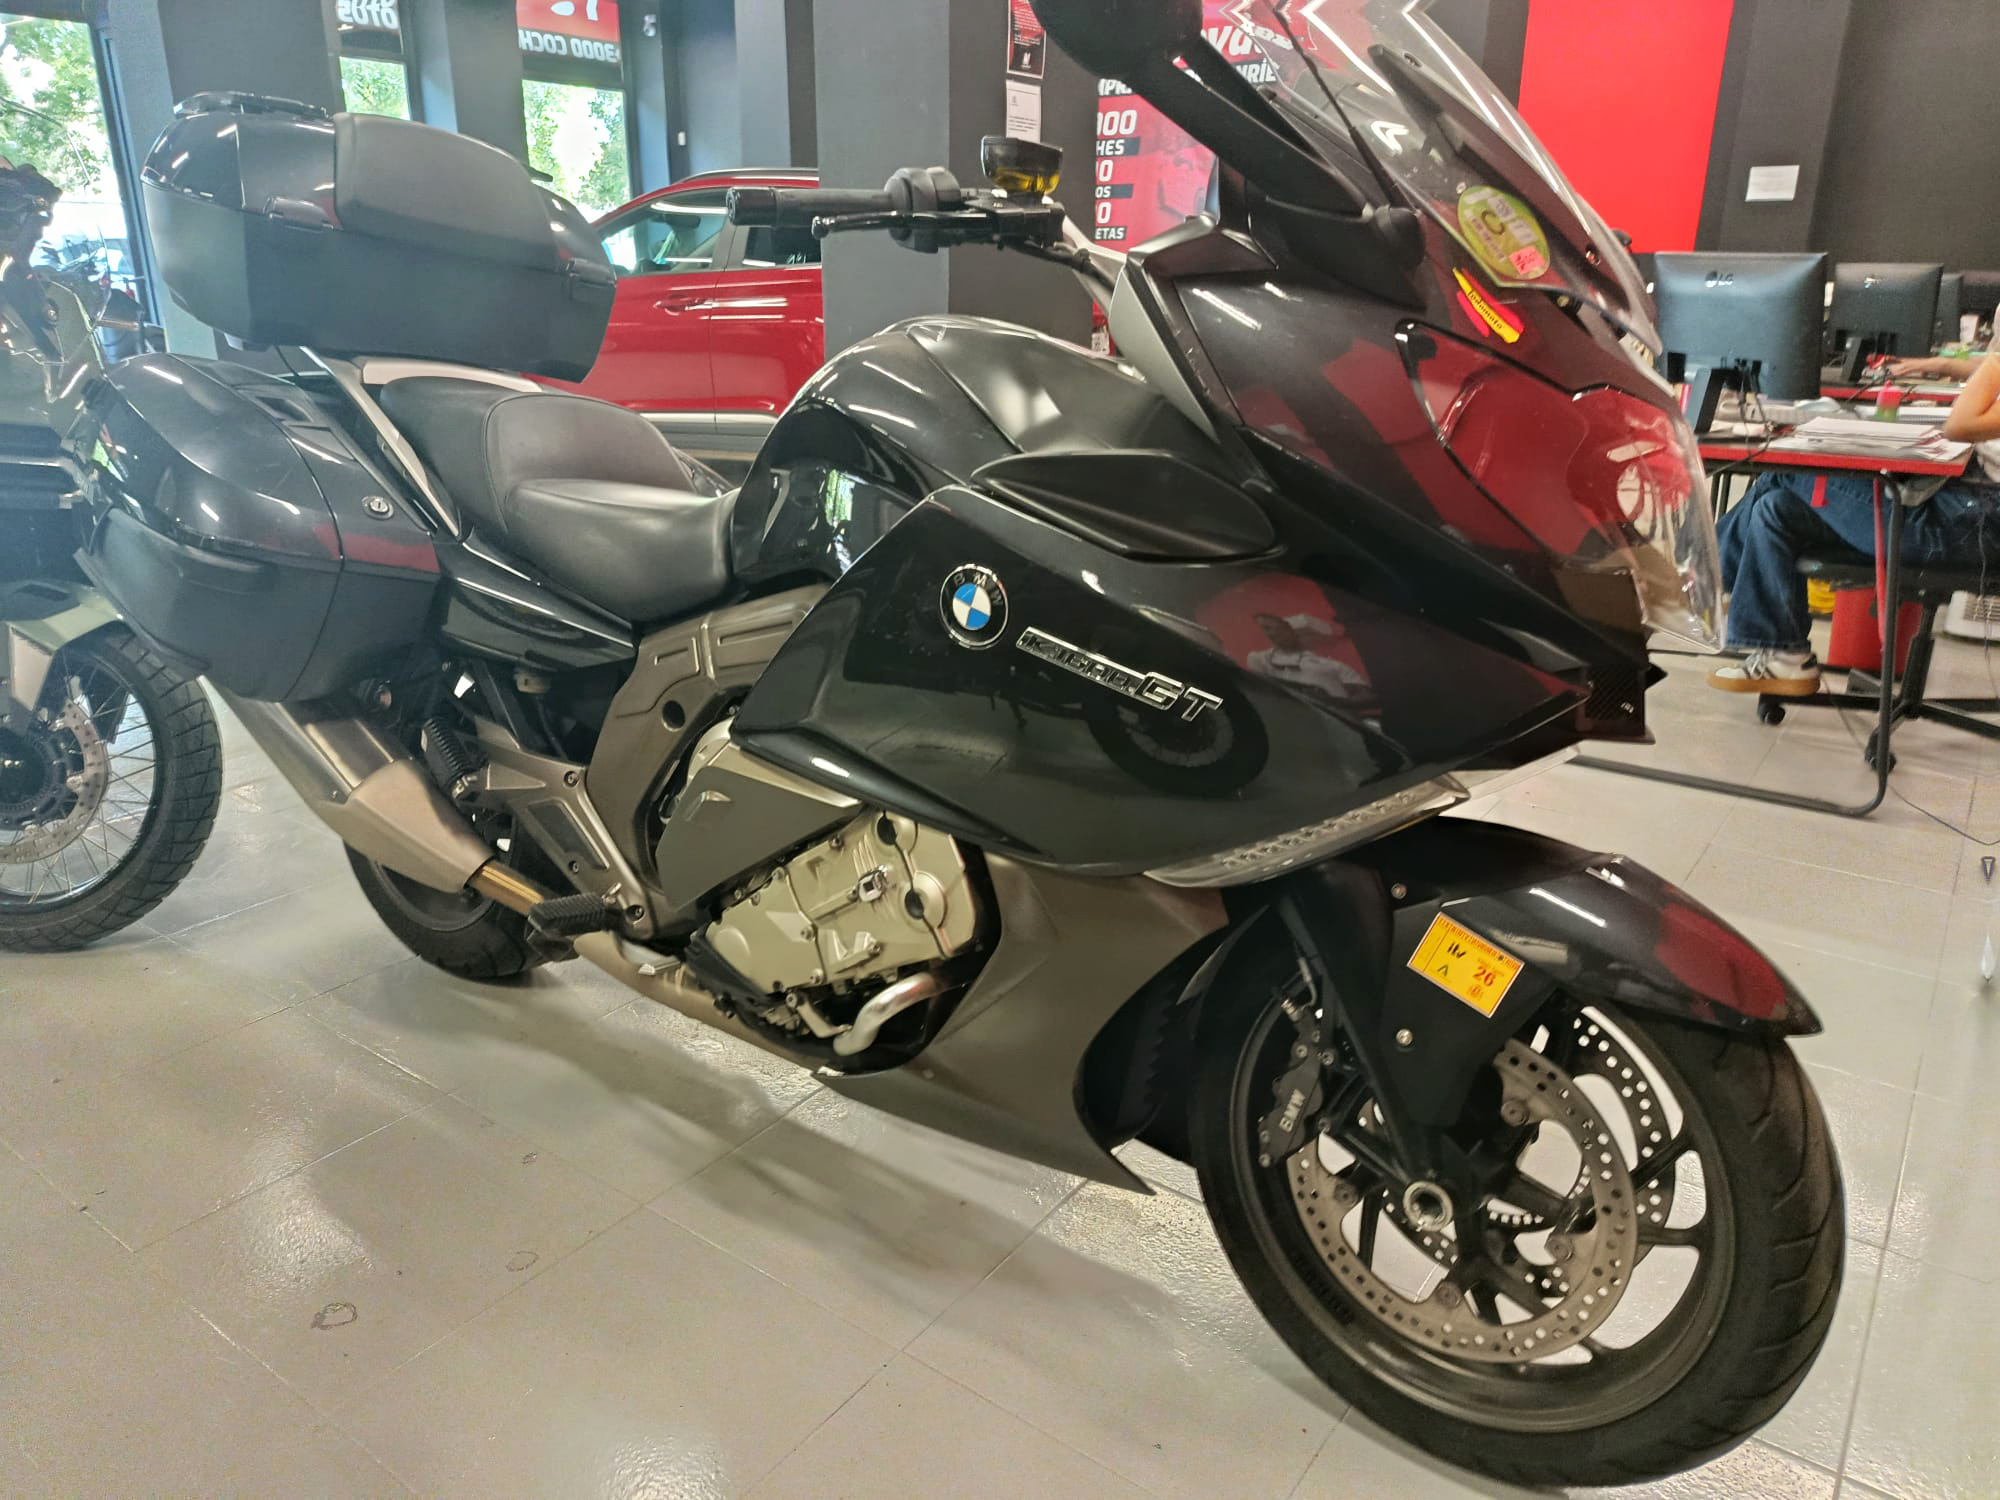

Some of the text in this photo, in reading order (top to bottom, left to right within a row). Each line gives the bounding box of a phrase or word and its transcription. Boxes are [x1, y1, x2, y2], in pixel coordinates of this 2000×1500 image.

[1096, 159, 1114, 182] 0
[1095, 201, 1112, 224] 0
[953, 571, 1004, 606] BMW
[1136, 671, 1224, 722] GT
[1471, 964, 1497, 987] 26
[1279, 1088, 1306, 1133] BMW
